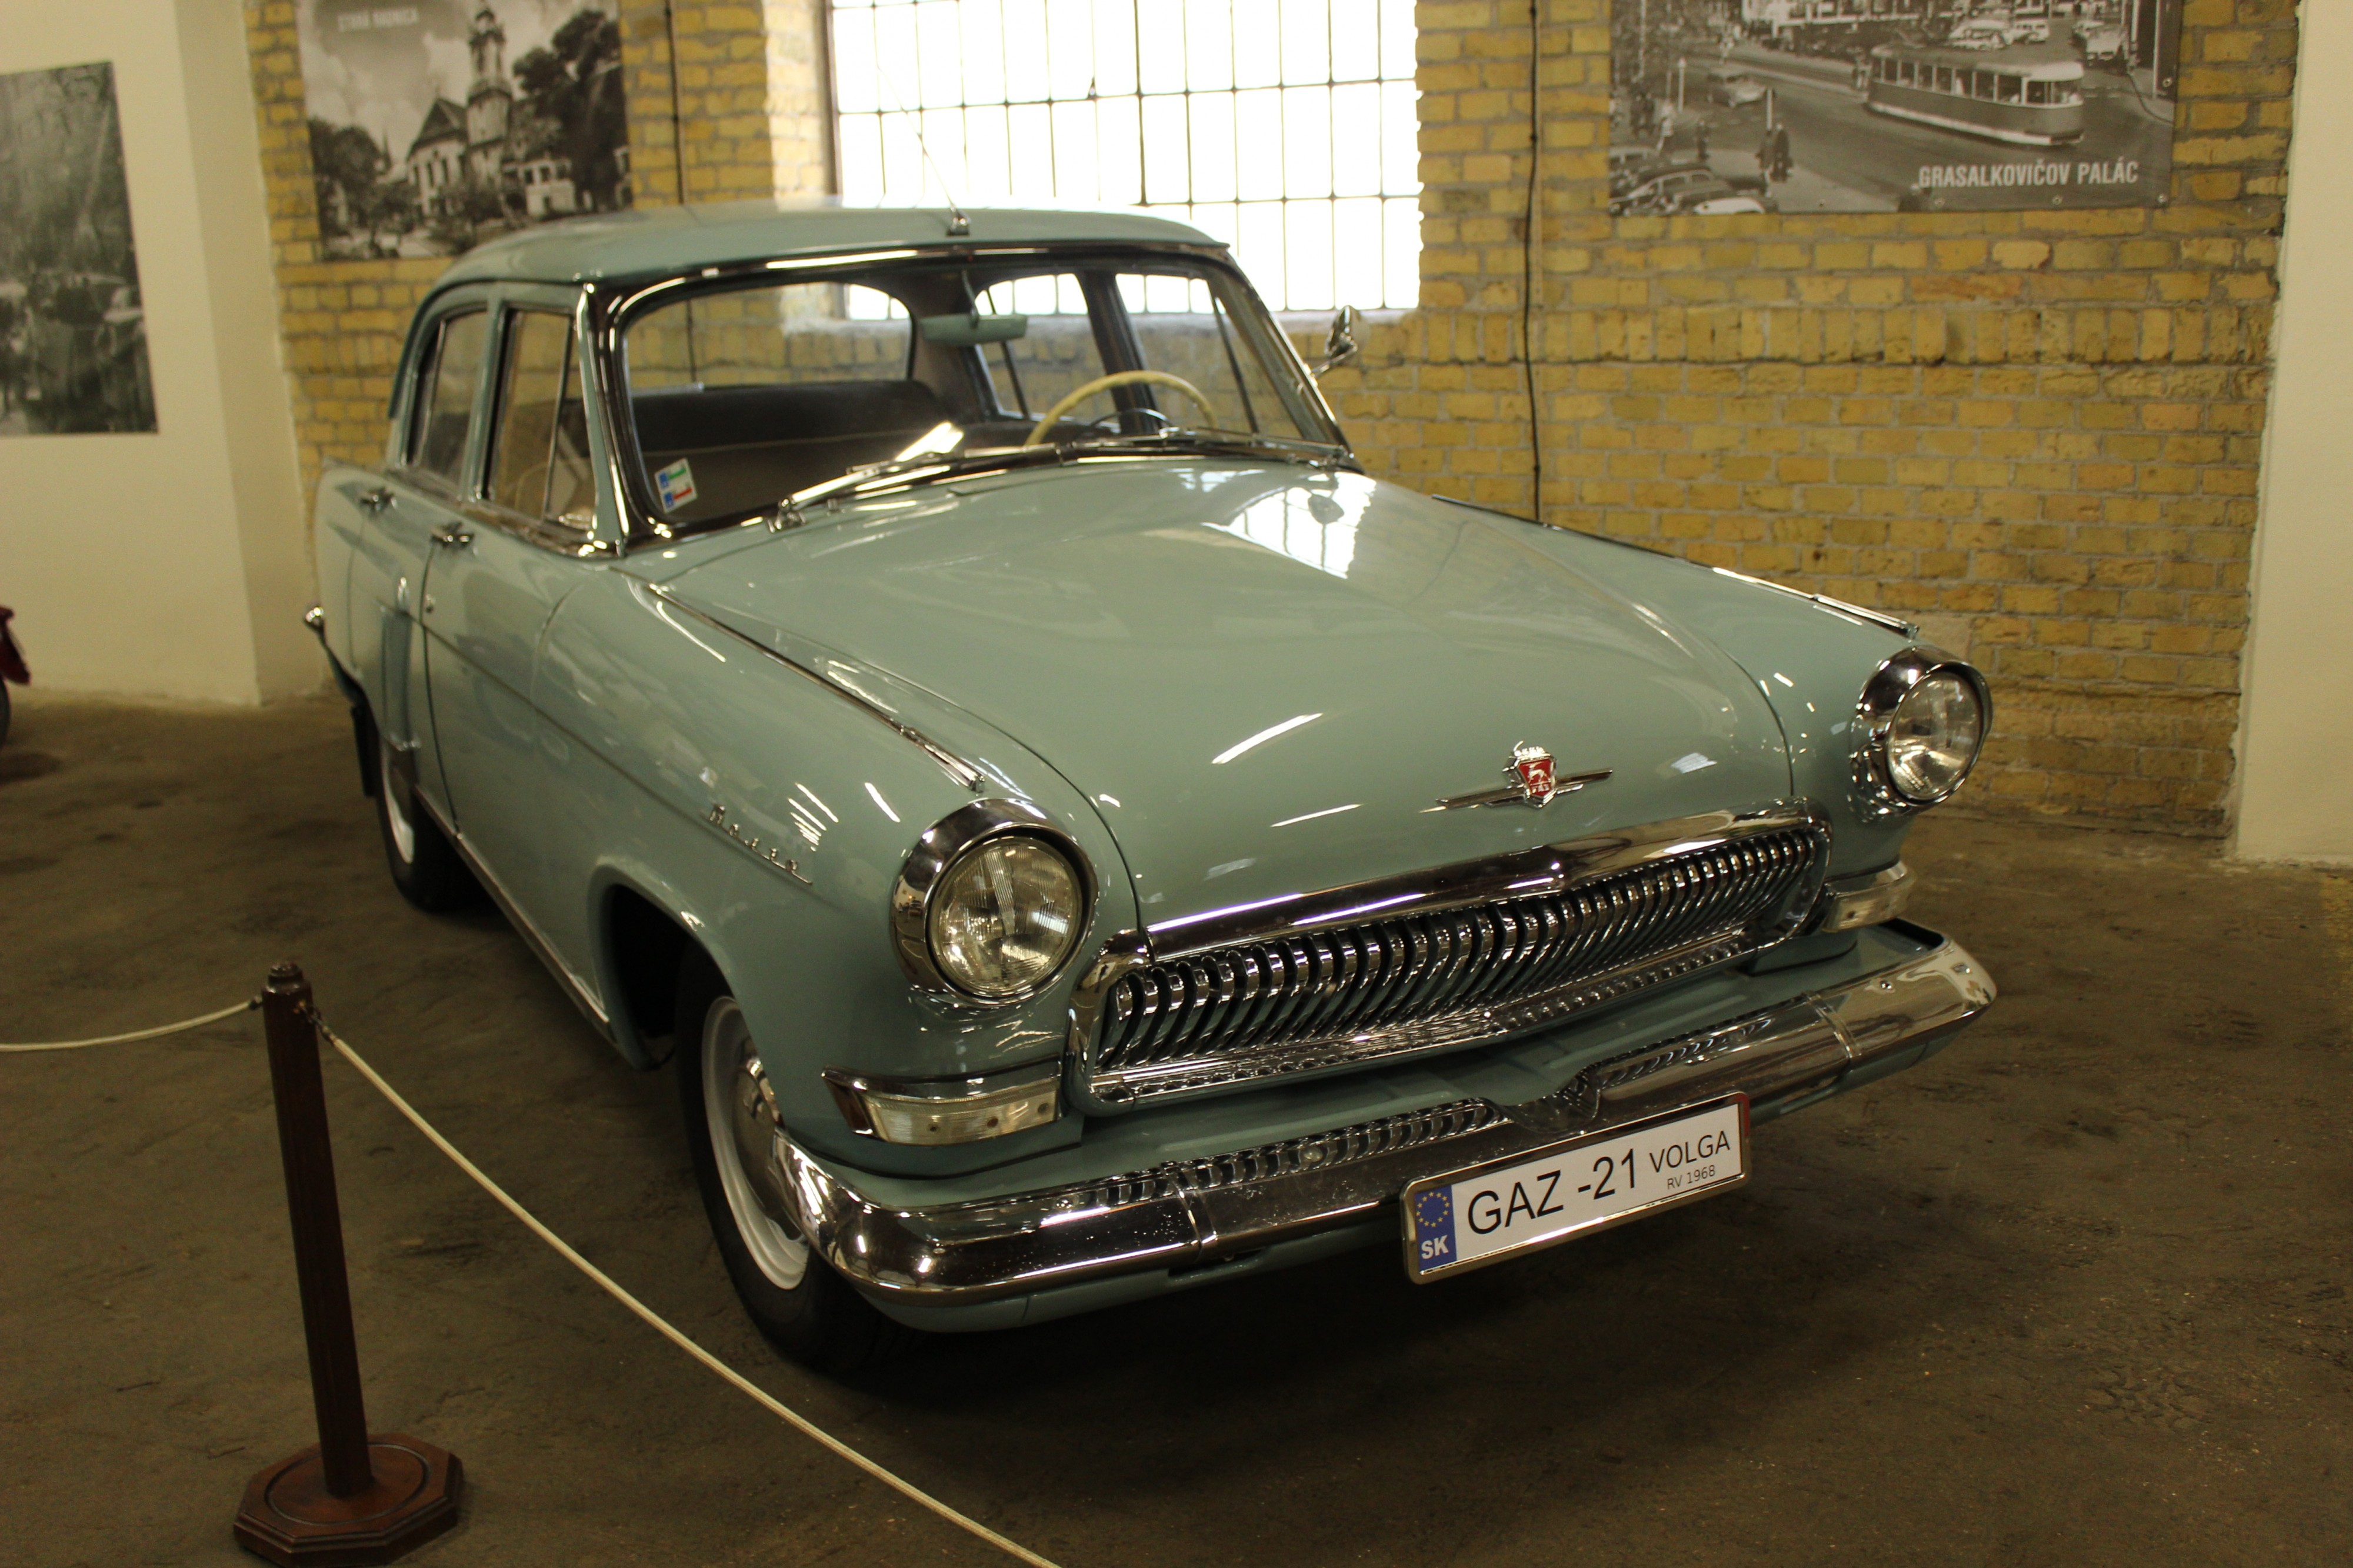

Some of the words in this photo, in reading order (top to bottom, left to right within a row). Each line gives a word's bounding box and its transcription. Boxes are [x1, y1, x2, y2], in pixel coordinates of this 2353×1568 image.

[1918, 158, 2071, 187] GRASALKOVIČOV
[2077, 156, 2139, 185] PALÁC
[1468, 1169, 1564, 1235] GAZ
[1578, 1148, 1635, 1200] -21
[1649, 1130, 1731, 1173] VOLGA
[1667, 1175, 1683, 1190] RV
[1687, 1164, 1716, 1184] 1968
[1421, 1235, 1449, 1259] SK
